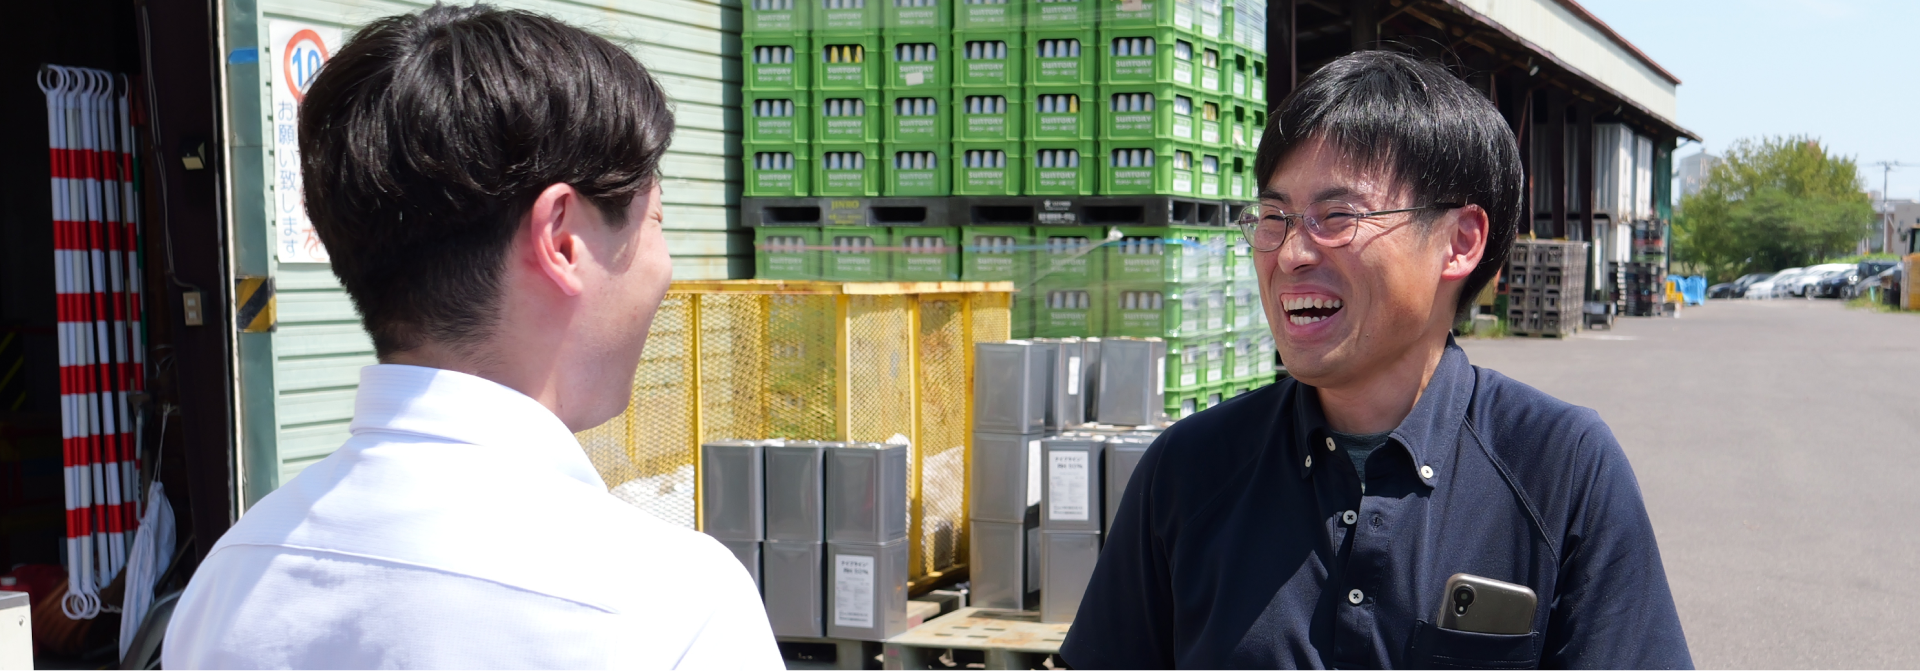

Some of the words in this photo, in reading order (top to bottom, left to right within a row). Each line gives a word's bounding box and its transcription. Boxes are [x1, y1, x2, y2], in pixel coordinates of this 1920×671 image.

[970, 8, 1004, 17] SUNTORY
[1042, 5, 1077, 14] SUNTORY
[758, 13, 791, 22] SUNTORY
[828, 12, 862, 21] SUNTORY
[900, 10, 934, 19] SUNTORY
[969, 63, 1004, 72] SUNTORY
[1042, 60, 1077, 69] SUNTORY
[1116, 59, 1152, 68] SUNTORY
[758, 67, 791, 76] SUNTORY
[828, 66, 861, 75] SUNTORY
[900, 64, 934, 73] SUNTORY
[828, 120, 862, 128] SUNTORY
[899, 118, 934, 127] SUNTORY
[969, 117, 1004, 126] SUNTORY
[1041, 116, 1076, 125] SUNTORY
[1116, 115, 1151, 124] SUNTORY
[758, 120, 791, 129] SUNTORY
[759, 173, 792, 182] SUNTORY
[828, 172, 862, 181] SUNTORY
[899, 172, 933, 181] SUNTORY
[968, 170, 1003, 179] SUNTORY
[1041, 170, 1076, 179] SUNTORY
[1115, 170, 1151, 179] SUNTORY
[278, 101, 298, 258] お願い致します
